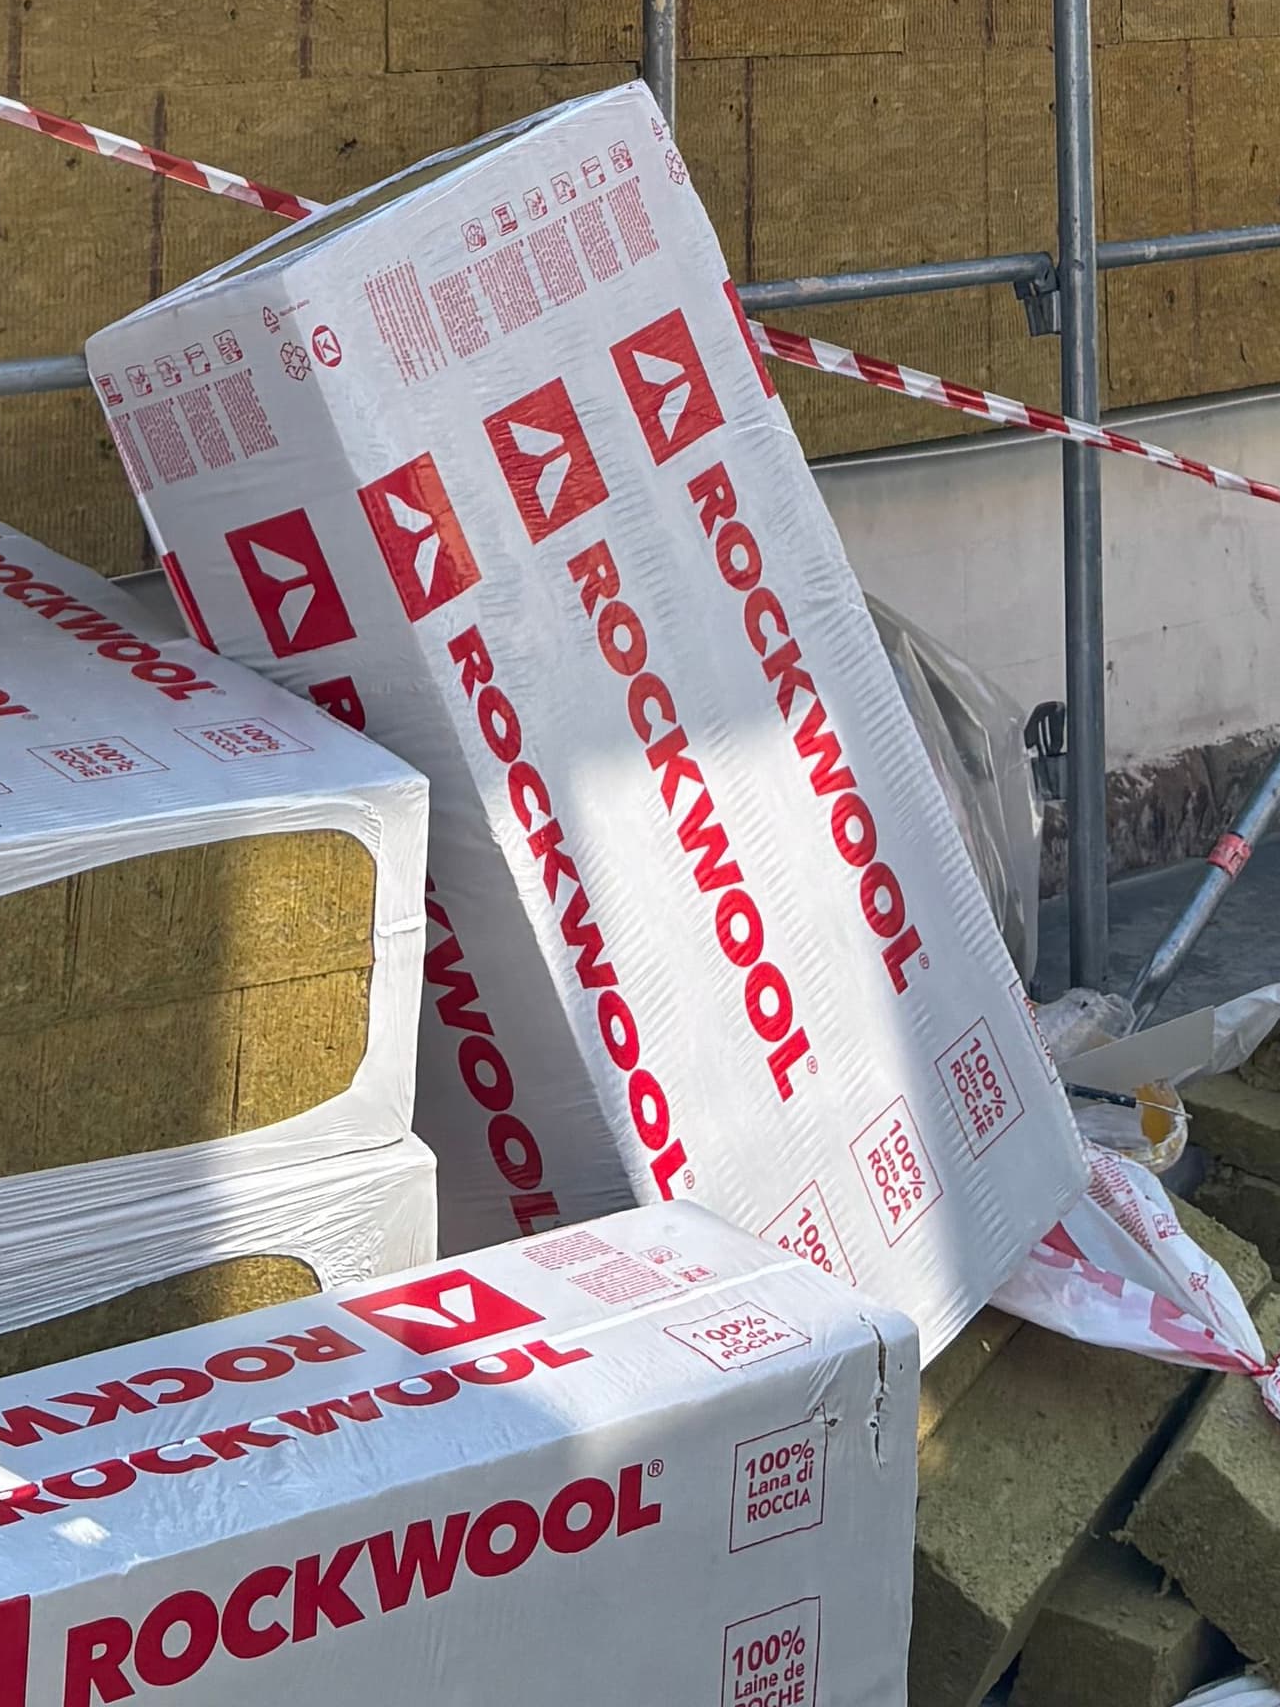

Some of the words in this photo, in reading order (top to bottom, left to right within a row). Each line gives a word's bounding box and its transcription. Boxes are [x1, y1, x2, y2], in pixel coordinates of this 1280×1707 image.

[87, 742, 140, 772] 100%
[686, 460, 917, 995] ROCKWOOL
[51, 749, 98, 778] ROCHE
[567, 538, 810, 1102] ROCKWOOL
[445, 624, 690, 1200] ROCKWOOL
[950, 1061, 990, 1139] ROCHE
[959, 1050, 983, 1100] Laine
[982, 1103, 995, 1128] de
[968, 1037, 1007, 1120] 100%
[868, 1148, 902, 1226] ROCA
[879, 1137, 900, 1182] Lana
[899, 1187, 913, 1211] de
[888, 1119, 926, 1200] 100%
[692, 1315, 766, 1344] 100%
[721, 1331, 791, 1360] ROCHA
[746, 1327, 768, 1340] de
[744, 1438, 815, 1480] 100%
[748, 1469, 792, 1499] Lana
[796, 1460, 814, 1485] di
[746, 1487, 812, 1523] ROCCIA
[64, 1461, 661, 1706] ROCKWOOL
[732, 1625, 806, 1678] 100%
[734, 1670, 779, 1701] Laine
[783, 1660, 805, 1684] de
